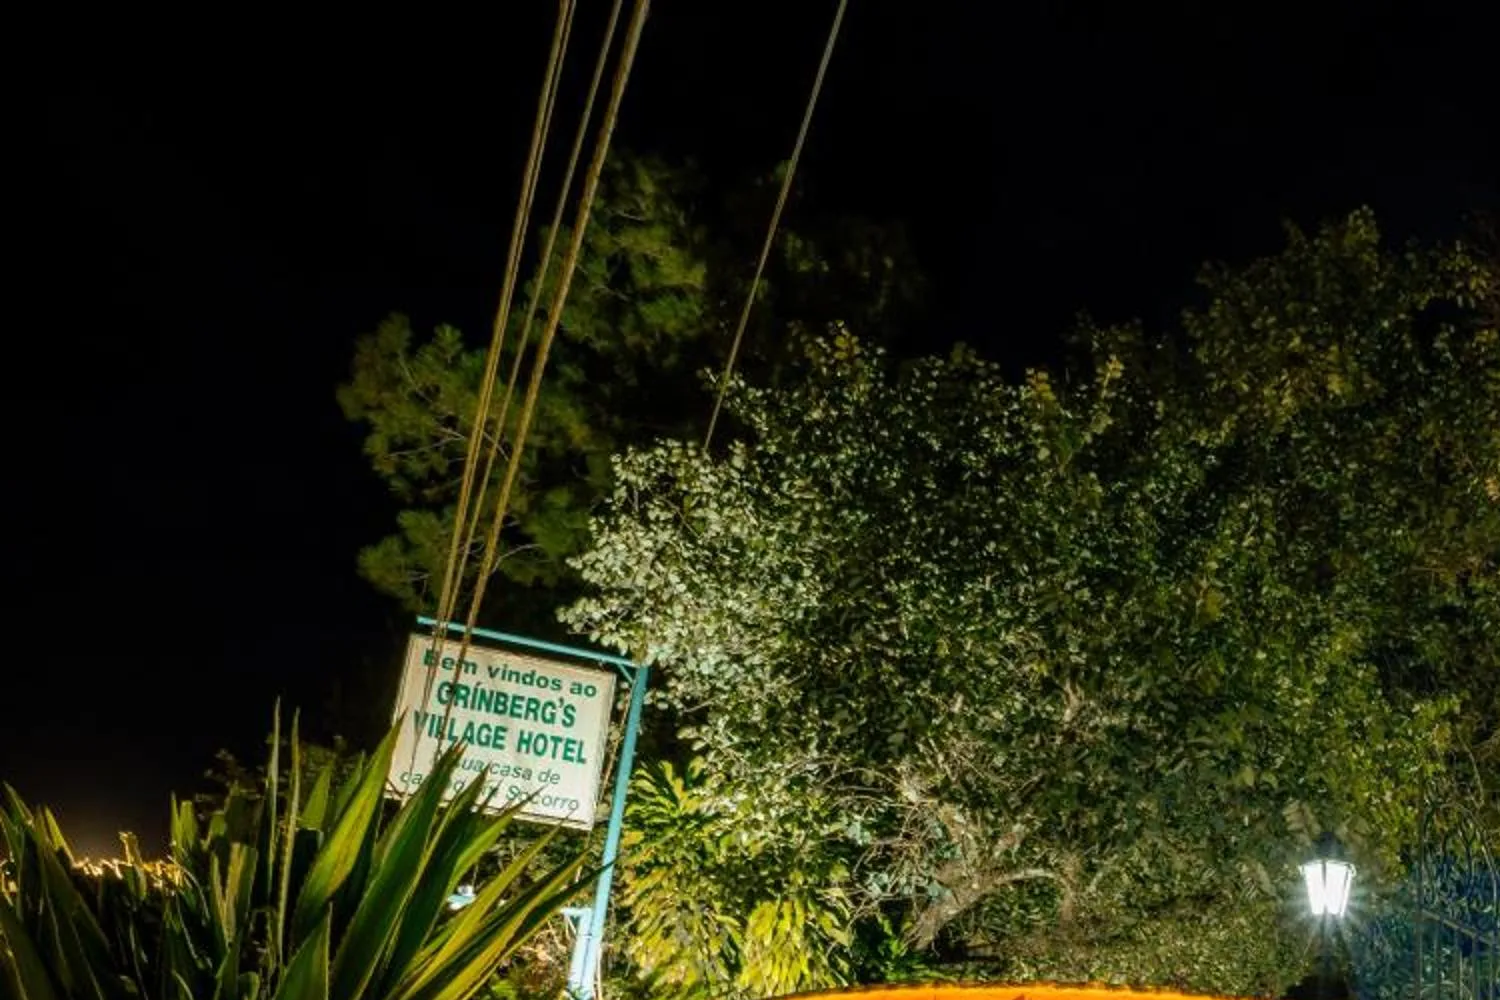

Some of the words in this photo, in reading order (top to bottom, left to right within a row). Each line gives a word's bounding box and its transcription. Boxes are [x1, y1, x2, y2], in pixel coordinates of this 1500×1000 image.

[488, 663, 562, 691] vindos
[570, 681, 597, 699] ao
[413, 710, 508, 751] VILLAGE
[516, 729, 587, 765] HOTEL
[489, 761, 533, 781] casa
[537, 768, 561, 785] de
